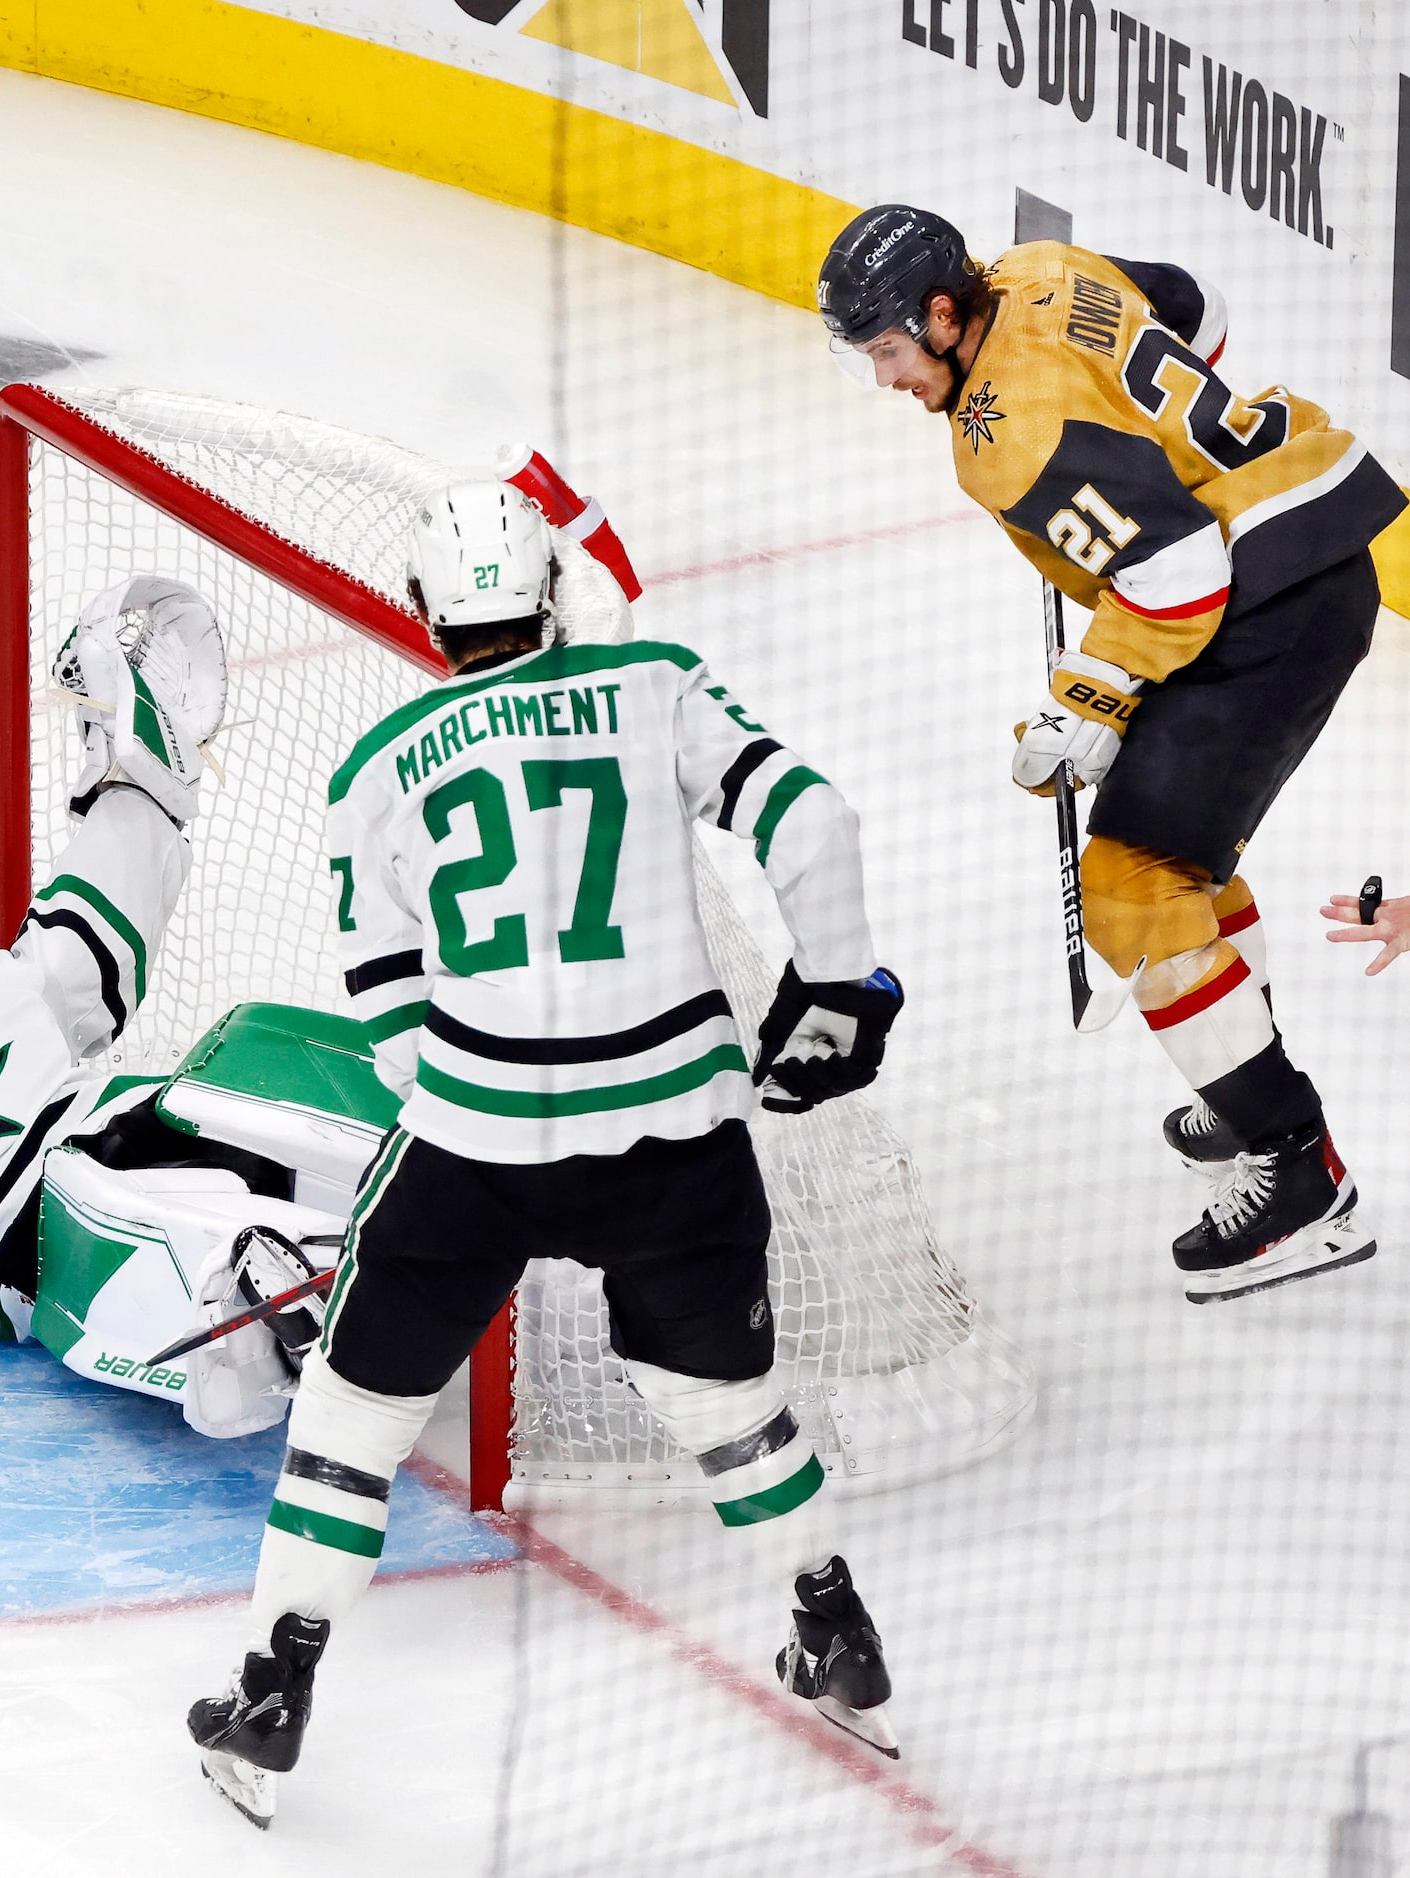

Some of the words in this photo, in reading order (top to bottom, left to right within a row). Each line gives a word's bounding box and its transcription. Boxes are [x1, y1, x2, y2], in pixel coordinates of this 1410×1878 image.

[1038, 0, 1097, 122] DO
[1111, 9, 1191, 173] THE
[1201, 54, 1334, 250] WORK.
[474, 563, 499, 590] 27
[1046, 483, 1142, 577] 21
[396, 683, 621, 795] MARCHMENT
[422, 756, 629, 978] 27
[93, 1351, 188, 1391] BAUER
